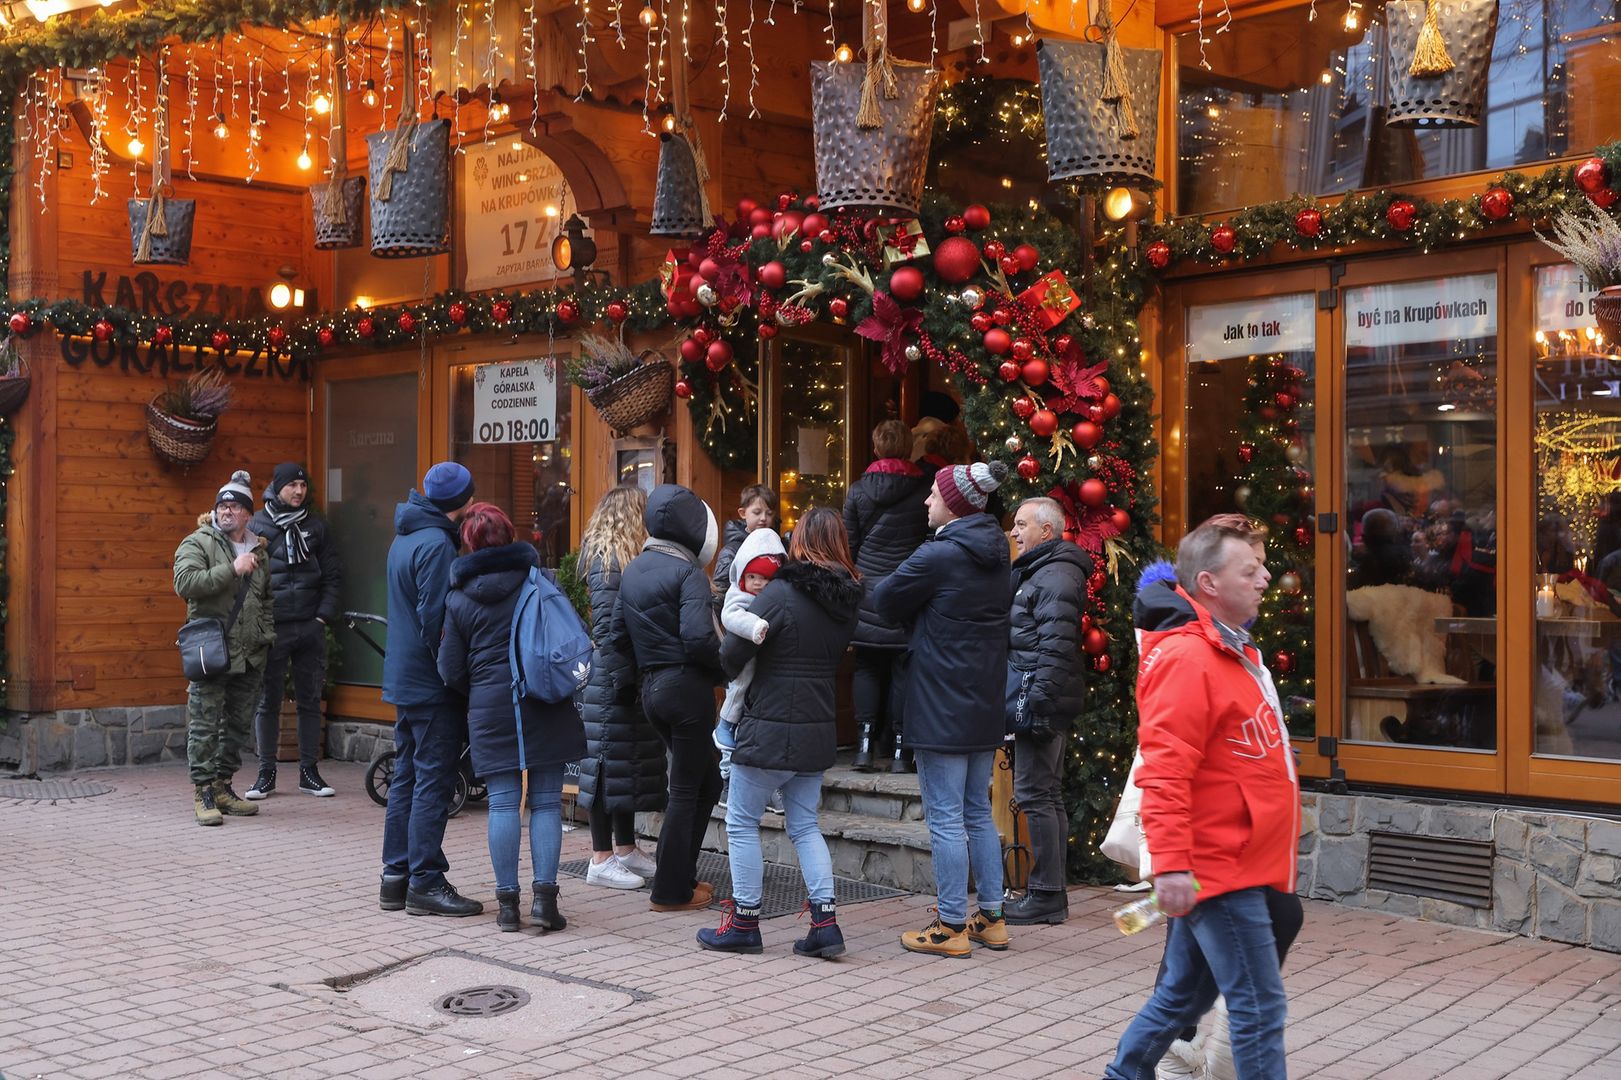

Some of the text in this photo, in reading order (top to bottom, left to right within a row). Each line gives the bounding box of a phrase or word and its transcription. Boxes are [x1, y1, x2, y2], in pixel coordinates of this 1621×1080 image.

[498, 148, 541, 168] NAJTAN
[481, 200, 496, 215] NA
[500, 220, 528, 256] 17
[496, 262, 525, 276] ZAPYTAJ
[1357, 298, 1487, 329] być na Krupówkach
[1565, 300, 1584, 318] do
[1223, 319, 1281, 341] Jak to tak
[500, 366, 529, 377] KAPELA
[493, 381, 535, 394] GÓRALSKA
[491, 397, 538, 409] CODZIENNIE
[479, 418, 549, 442] OD 18:00
